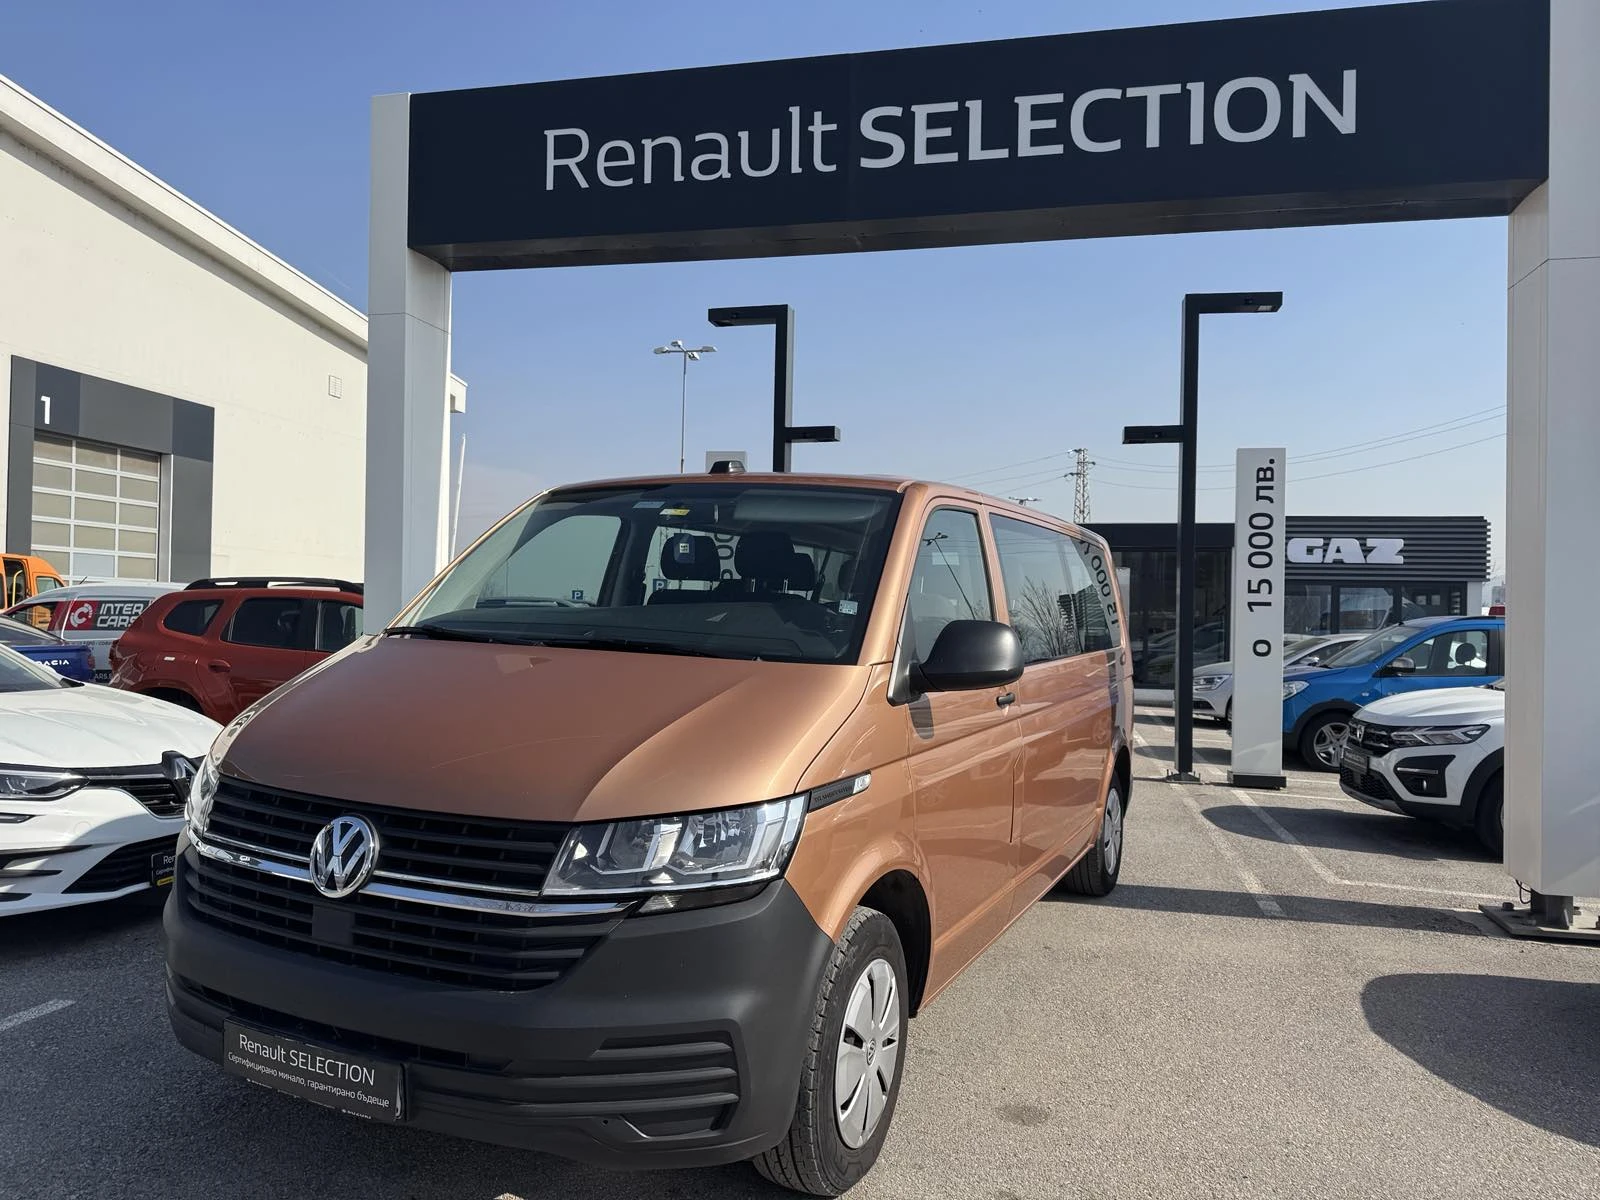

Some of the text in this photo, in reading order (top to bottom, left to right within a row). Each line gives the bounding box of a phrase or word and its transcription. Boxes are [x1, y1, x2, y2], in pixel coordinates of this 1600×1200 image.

[544, 69, 1357, 191] Renault SELECTION
[40, 395, 51, 425] 1
[1255, 458, 1275, 504] лв.
[1247, 512, 1275, 569] 000
[1287, 537, 1404, 564] GAZ
[99, 603, 144, 615] INTER
[1247, 578, 1273, 612] 15
[228, 1051, 278, 1077] Сертифицирано
[278, 1071, 307, 1087] минало,
[307, 1080, 356, 1099] гарантирано
[356, 1090, 390, 1108] бъдеще
[239, 1033, 375, 1086] Renault SELECTION
